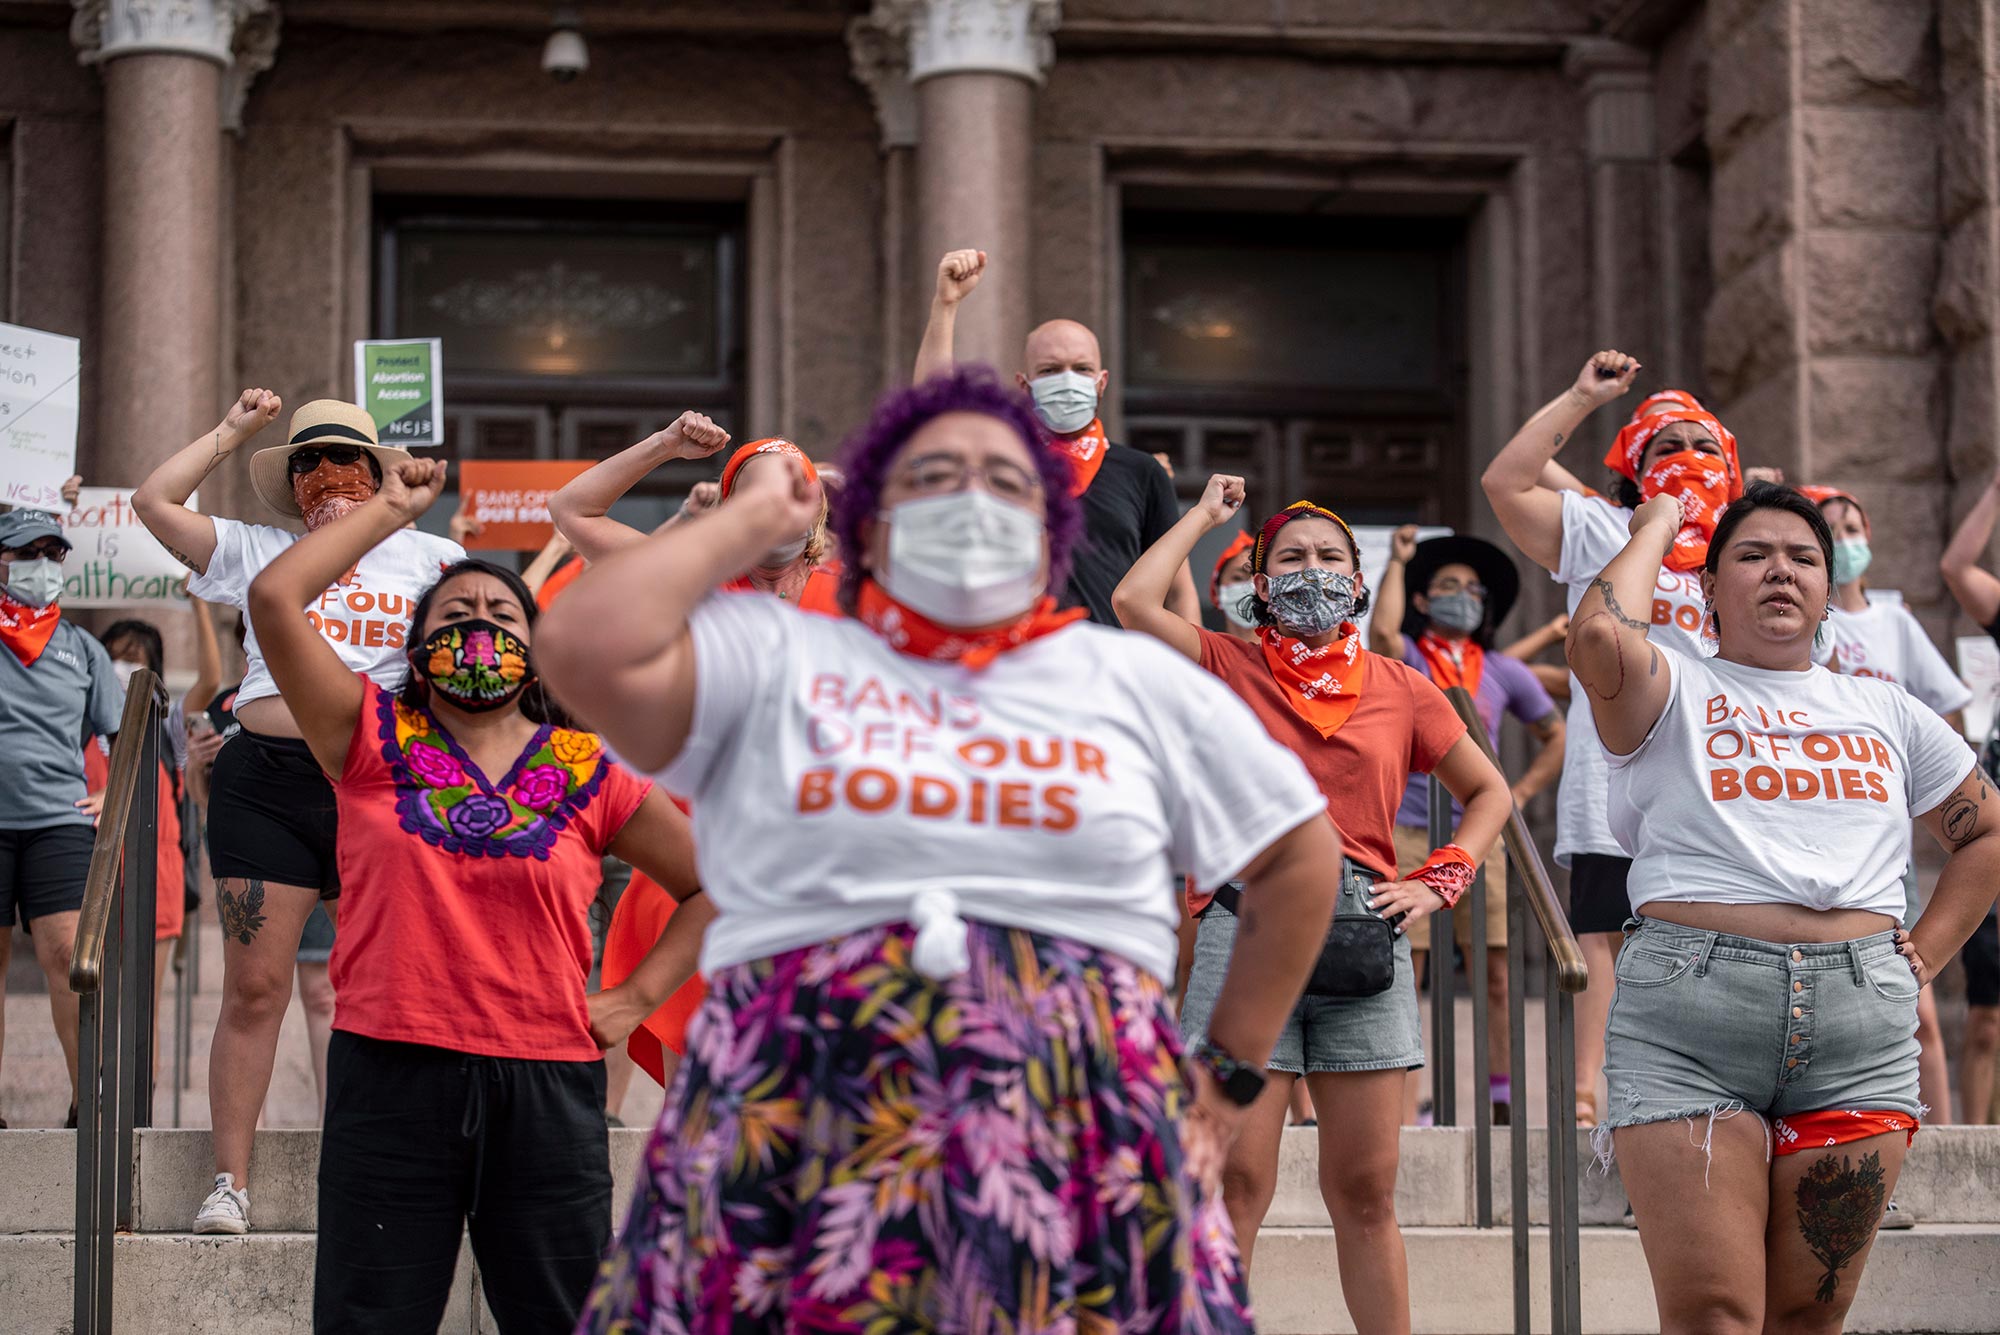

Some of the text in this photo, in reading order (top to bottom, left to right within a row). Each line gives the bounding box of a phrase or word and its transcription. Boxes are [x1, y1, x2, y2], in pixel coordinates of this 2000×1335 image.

[371, 371, 426, 385] Abortion
[376, 387, 421, 400] Access
[475, 507, 515, 523] OUR
[97, 530, 119, 559] is
[810, 673, 981, 731] BANS
[807, 716, 1109, 782] OFF OUR
[1706, 729, 1895, 773] OFF OUR
[796, 767, 1081, 834] BODIES
[1710, 765, 1889, 803] BODIES
[1775, 1118, 1799, 1143] OUR
